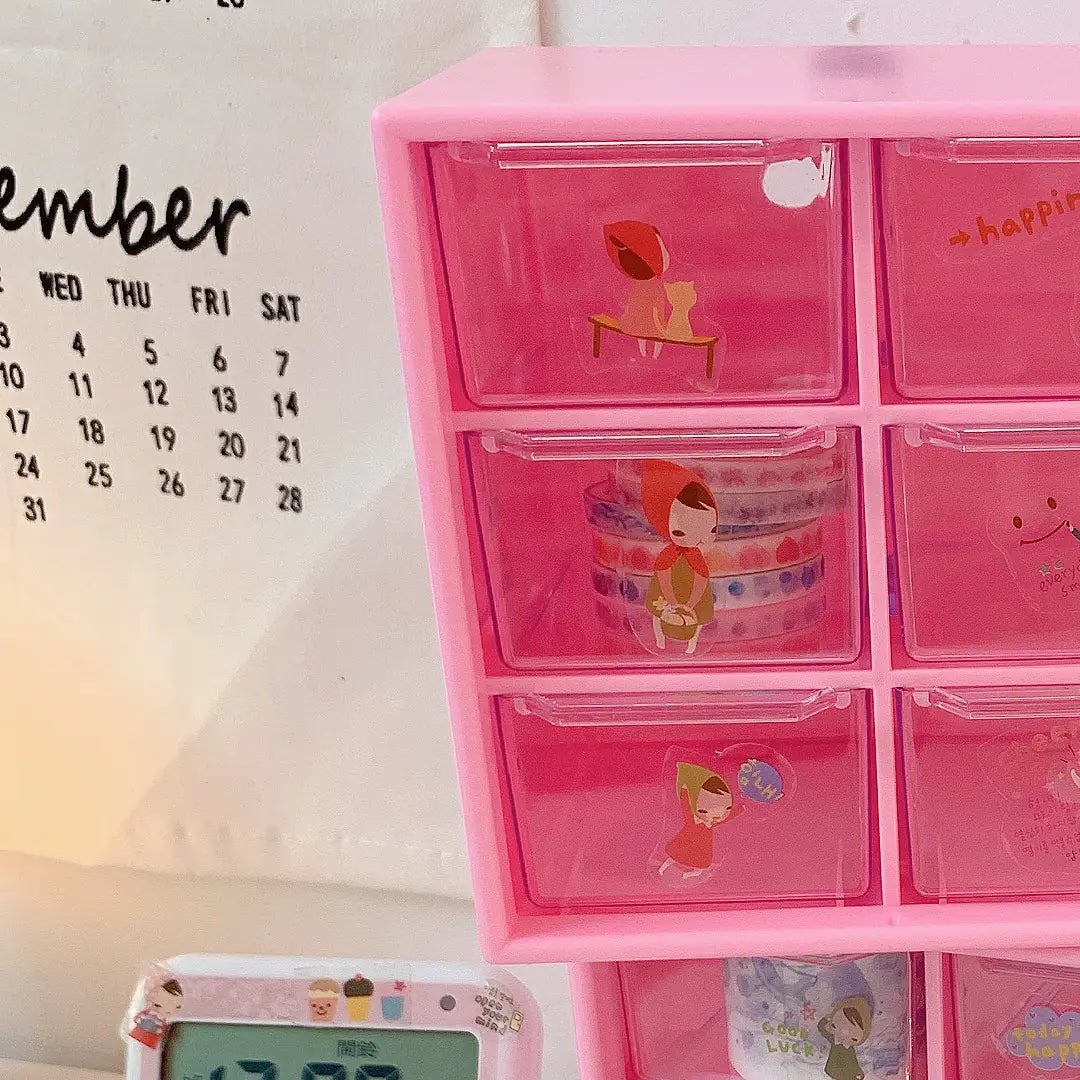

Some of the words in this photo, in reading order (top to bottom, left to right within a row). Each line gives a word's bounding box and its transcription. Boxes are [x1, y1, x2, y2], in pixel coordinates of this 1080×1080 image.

[39, 271, 83, 302] WED
[107, 278, 151, 308] THU
[191, 286, 230, 316] FRI
[262, 293, 301, 323] SAT
[72, 331, 86, 357] 4
[144, 338, 158, 365] 5
[213, 346, 228, 373] 6
[275, 350, 290, 377] 7
[0, 362, 24, 389] 10
[69, 372, 92, 399] 11
[143, 379, 168, 406] 12
[212, 386, 237, 414] 13
[273, 391, 299, 418] 14
[6, 409, 30, 435] 17
[79, 417, 105, 445] 18
[151, 425, 176, 451] 19
[219, 431, 245, 459] 20
[277, 436, 301, 464] 21
[14, 453, 40, 479] 24
[85, 461, 113, 489] 25
[159, 469, 185, 497] 26
[219, 476, 245, 504] 27
[277, 484, 302, 513] 28
[24, 496, 46, 522] 31
